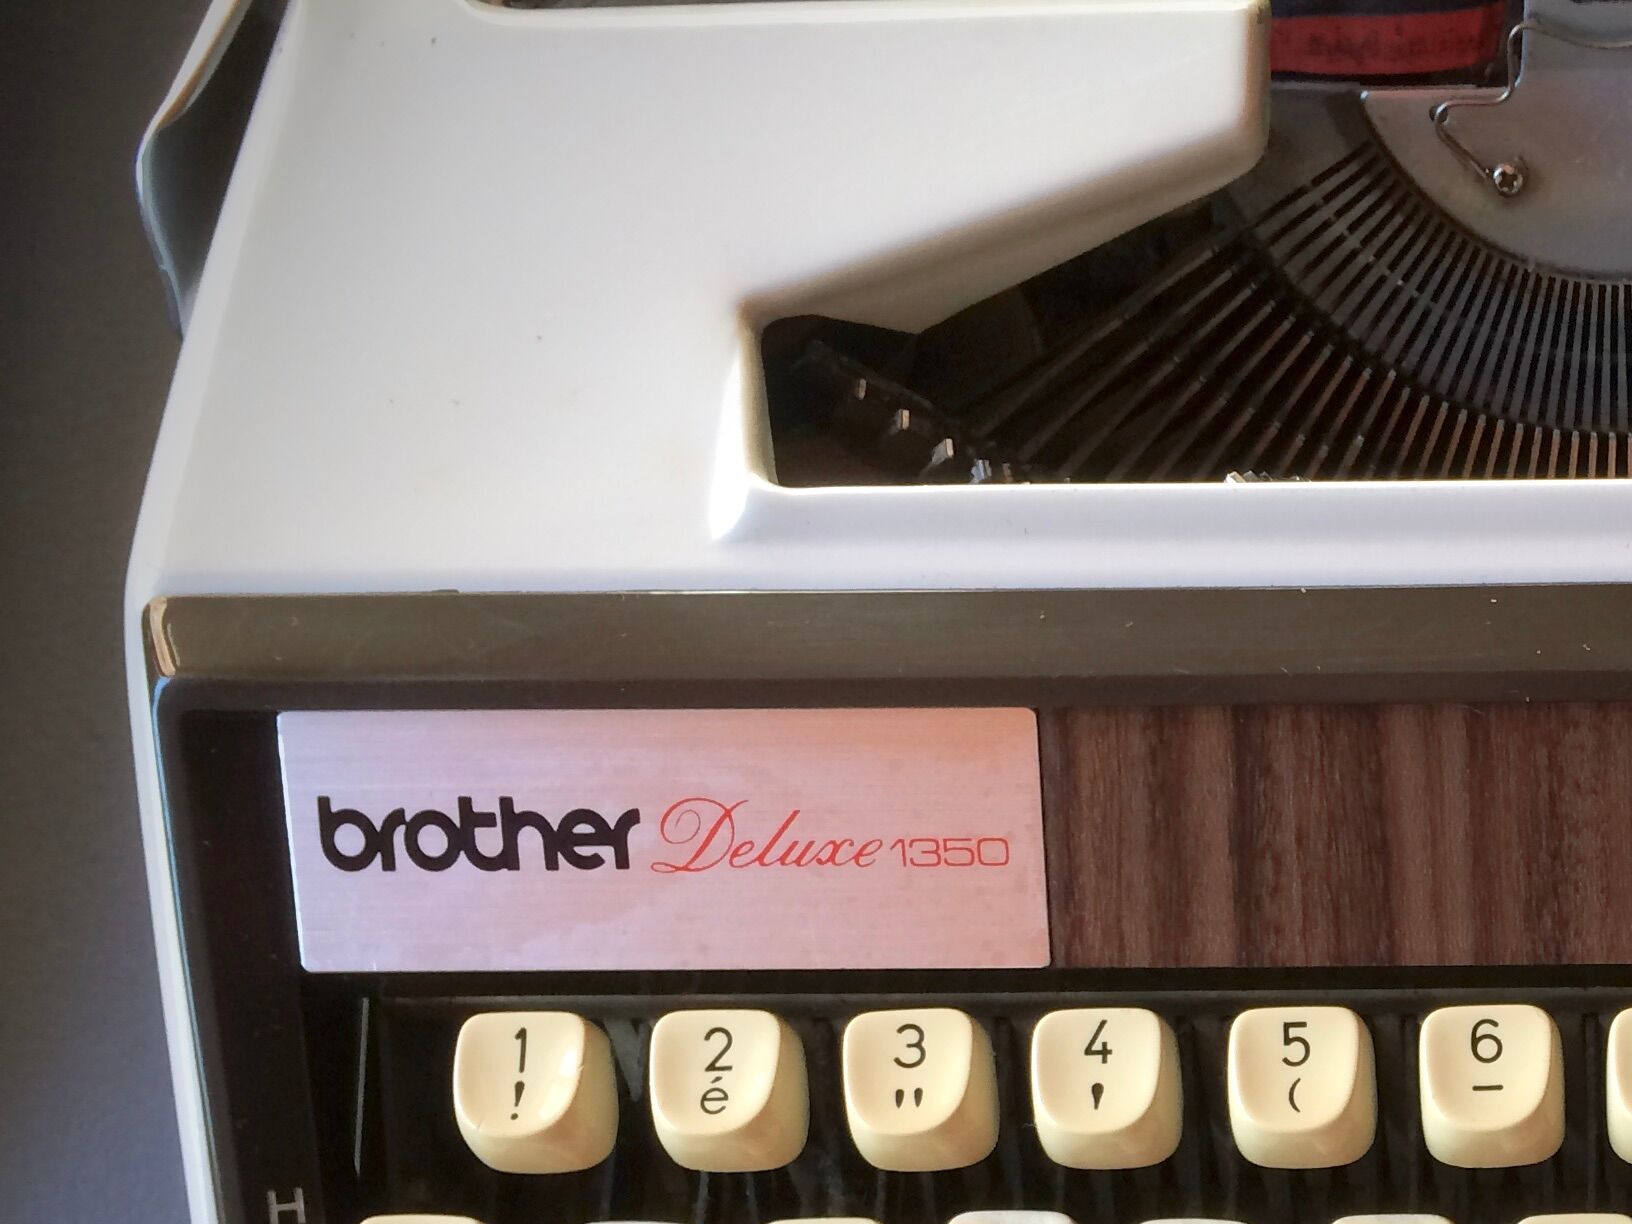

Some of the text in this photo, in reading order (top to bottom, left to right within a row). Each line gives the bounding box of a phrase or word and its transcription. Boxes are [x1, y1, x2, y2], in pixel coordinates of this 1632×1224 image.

[318, 796, 640, 872] brother
[651, 797, 1010, 874] Deluxe 1350
[515, 1028, 527, 1073] 1
[704, 1027, 732, 1072] 2
[894, 1024, 926, 1068] 3
[1084, 1020, 1112, 1064] 4
[1282, 1022, 1310, 1067] 5
[1471, 1019, 1503, 1063] 6
[511, 1081, 525, 1120] !
[700, 1076, 728, 1114] é
[1289, 1078, 1301, 1112] (
